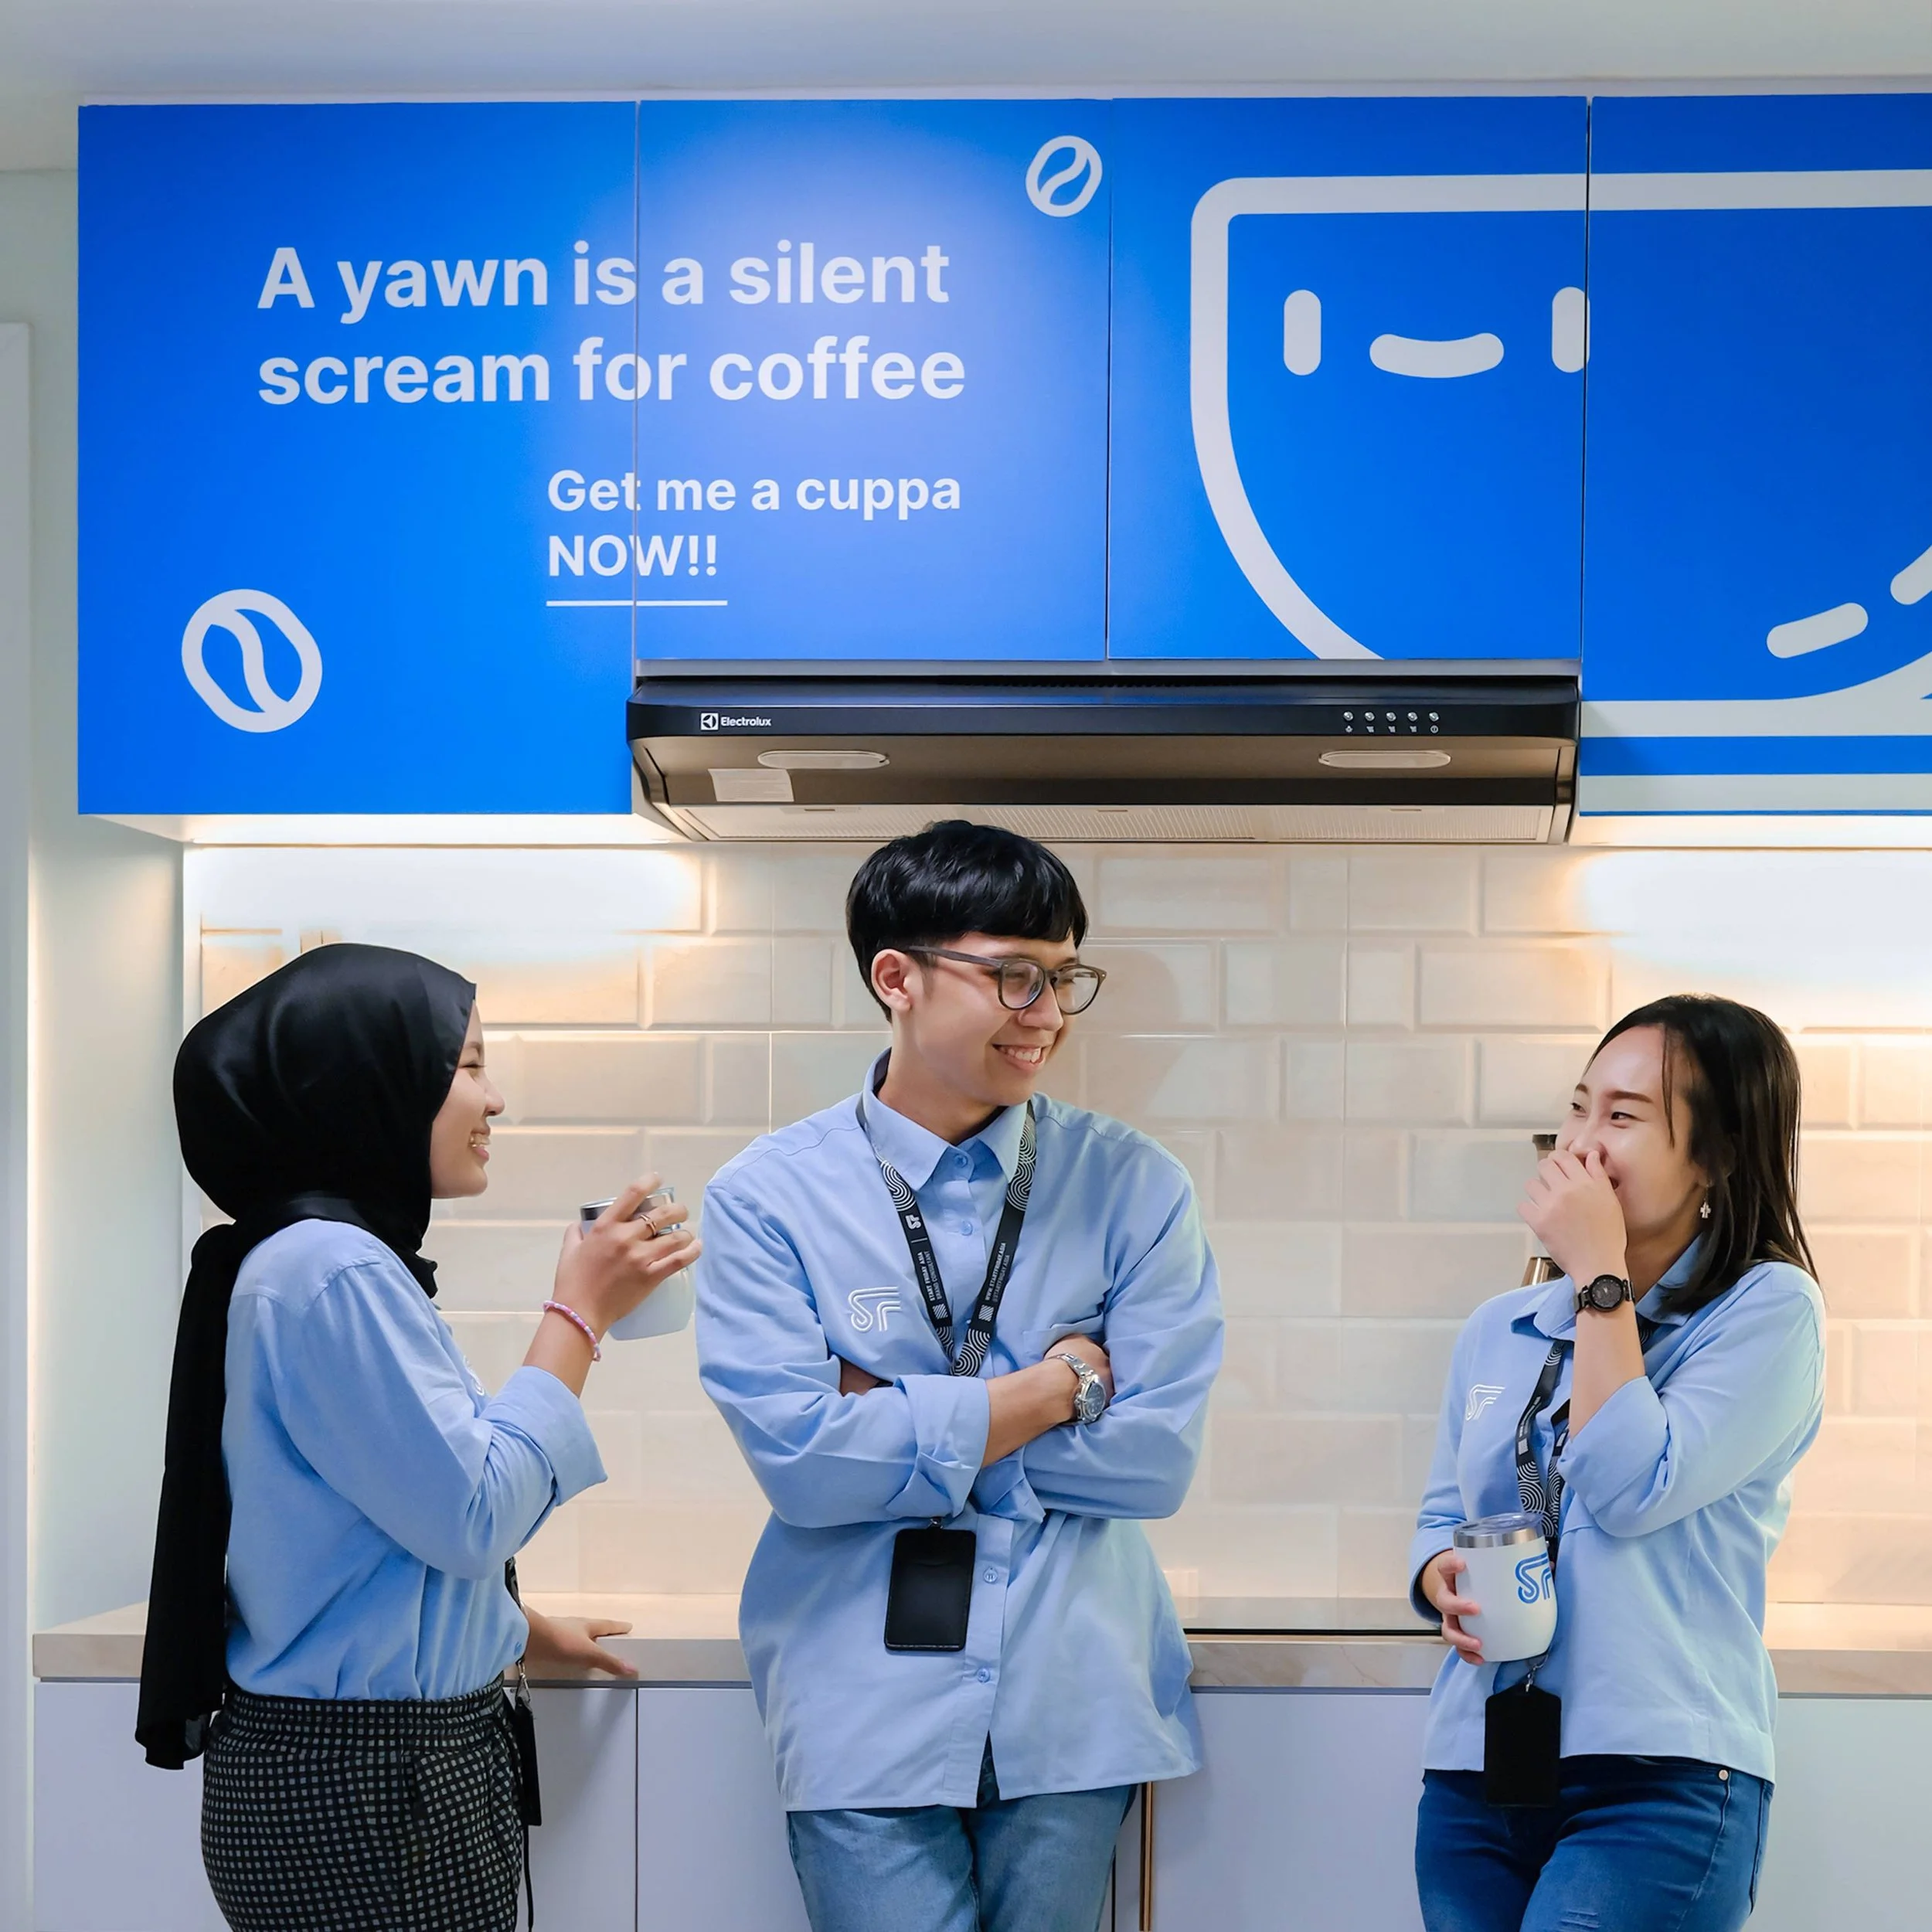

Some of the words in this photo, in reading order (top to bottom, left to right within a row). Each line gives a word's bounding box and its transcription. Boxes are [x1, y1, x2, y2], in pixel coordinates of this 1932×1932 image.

[257, 247, 315, 308] A
[337, 258, 548, 325] yawn
[573, 240, 636, 305] is
[662, 257, 704, 304] a
[730, 240, 950, 304] silent
[258, 354, 549, 405] scream
[573, 337, 687, 401] for
[709, 335, 965, 400] coffee
[548, 469, 641, 512] Get
[657, 478, 736, 511] me
[751, 478, 780, 511] a
[796, 478, 961, 521] cuppa
[548, 535, 717, 577] NOW!!
[720, 716, 772, 726] Electrolux
